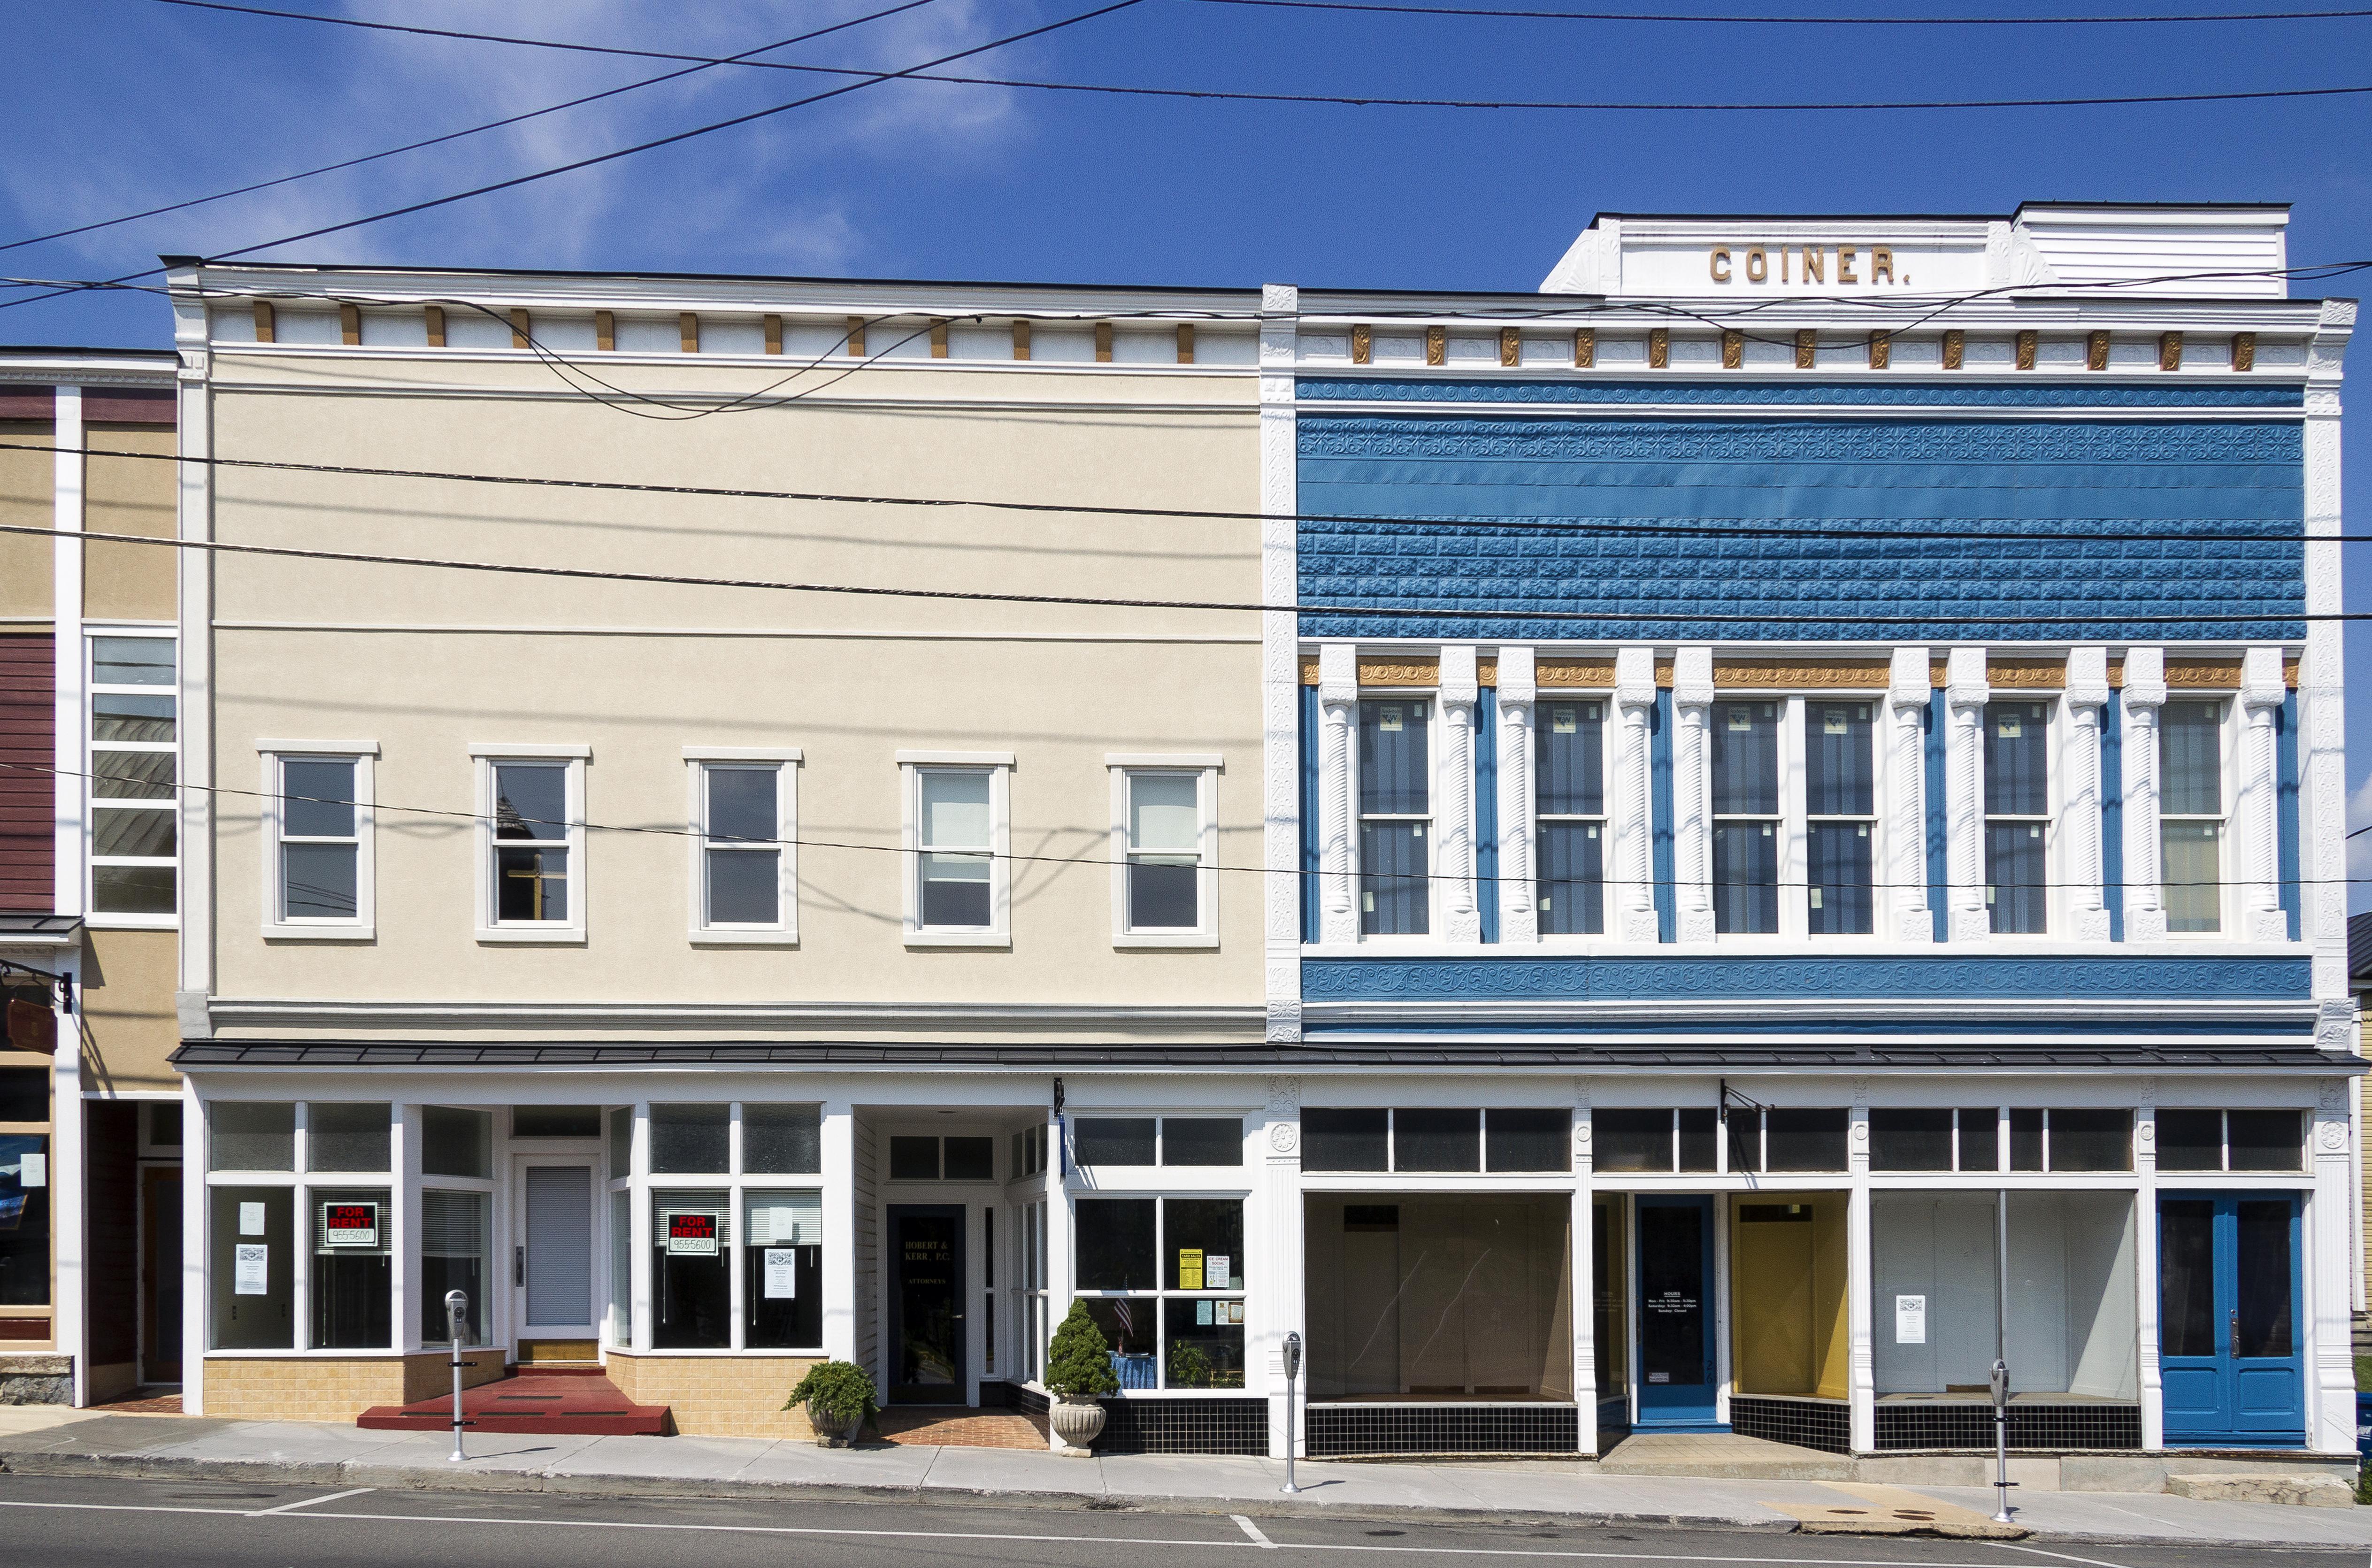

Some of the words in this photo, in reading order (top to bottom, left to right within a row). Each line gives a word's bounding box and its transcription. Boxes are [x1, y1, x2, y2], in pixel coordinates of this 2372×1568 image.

[338, 1207, 364, 1217] FOR
[330, 1218, 372, 1228] RENT
[679, 1216, 706, 1226] FOR
[333, 1230, 370, 1240] 955-5600
[671, 1227, 713, 1237] RENT
[674, 1239, 711, 1249] 955-5600
[905, 1240, 938, 1250] HOBERT
[940, 1240, 948, 1250] &
